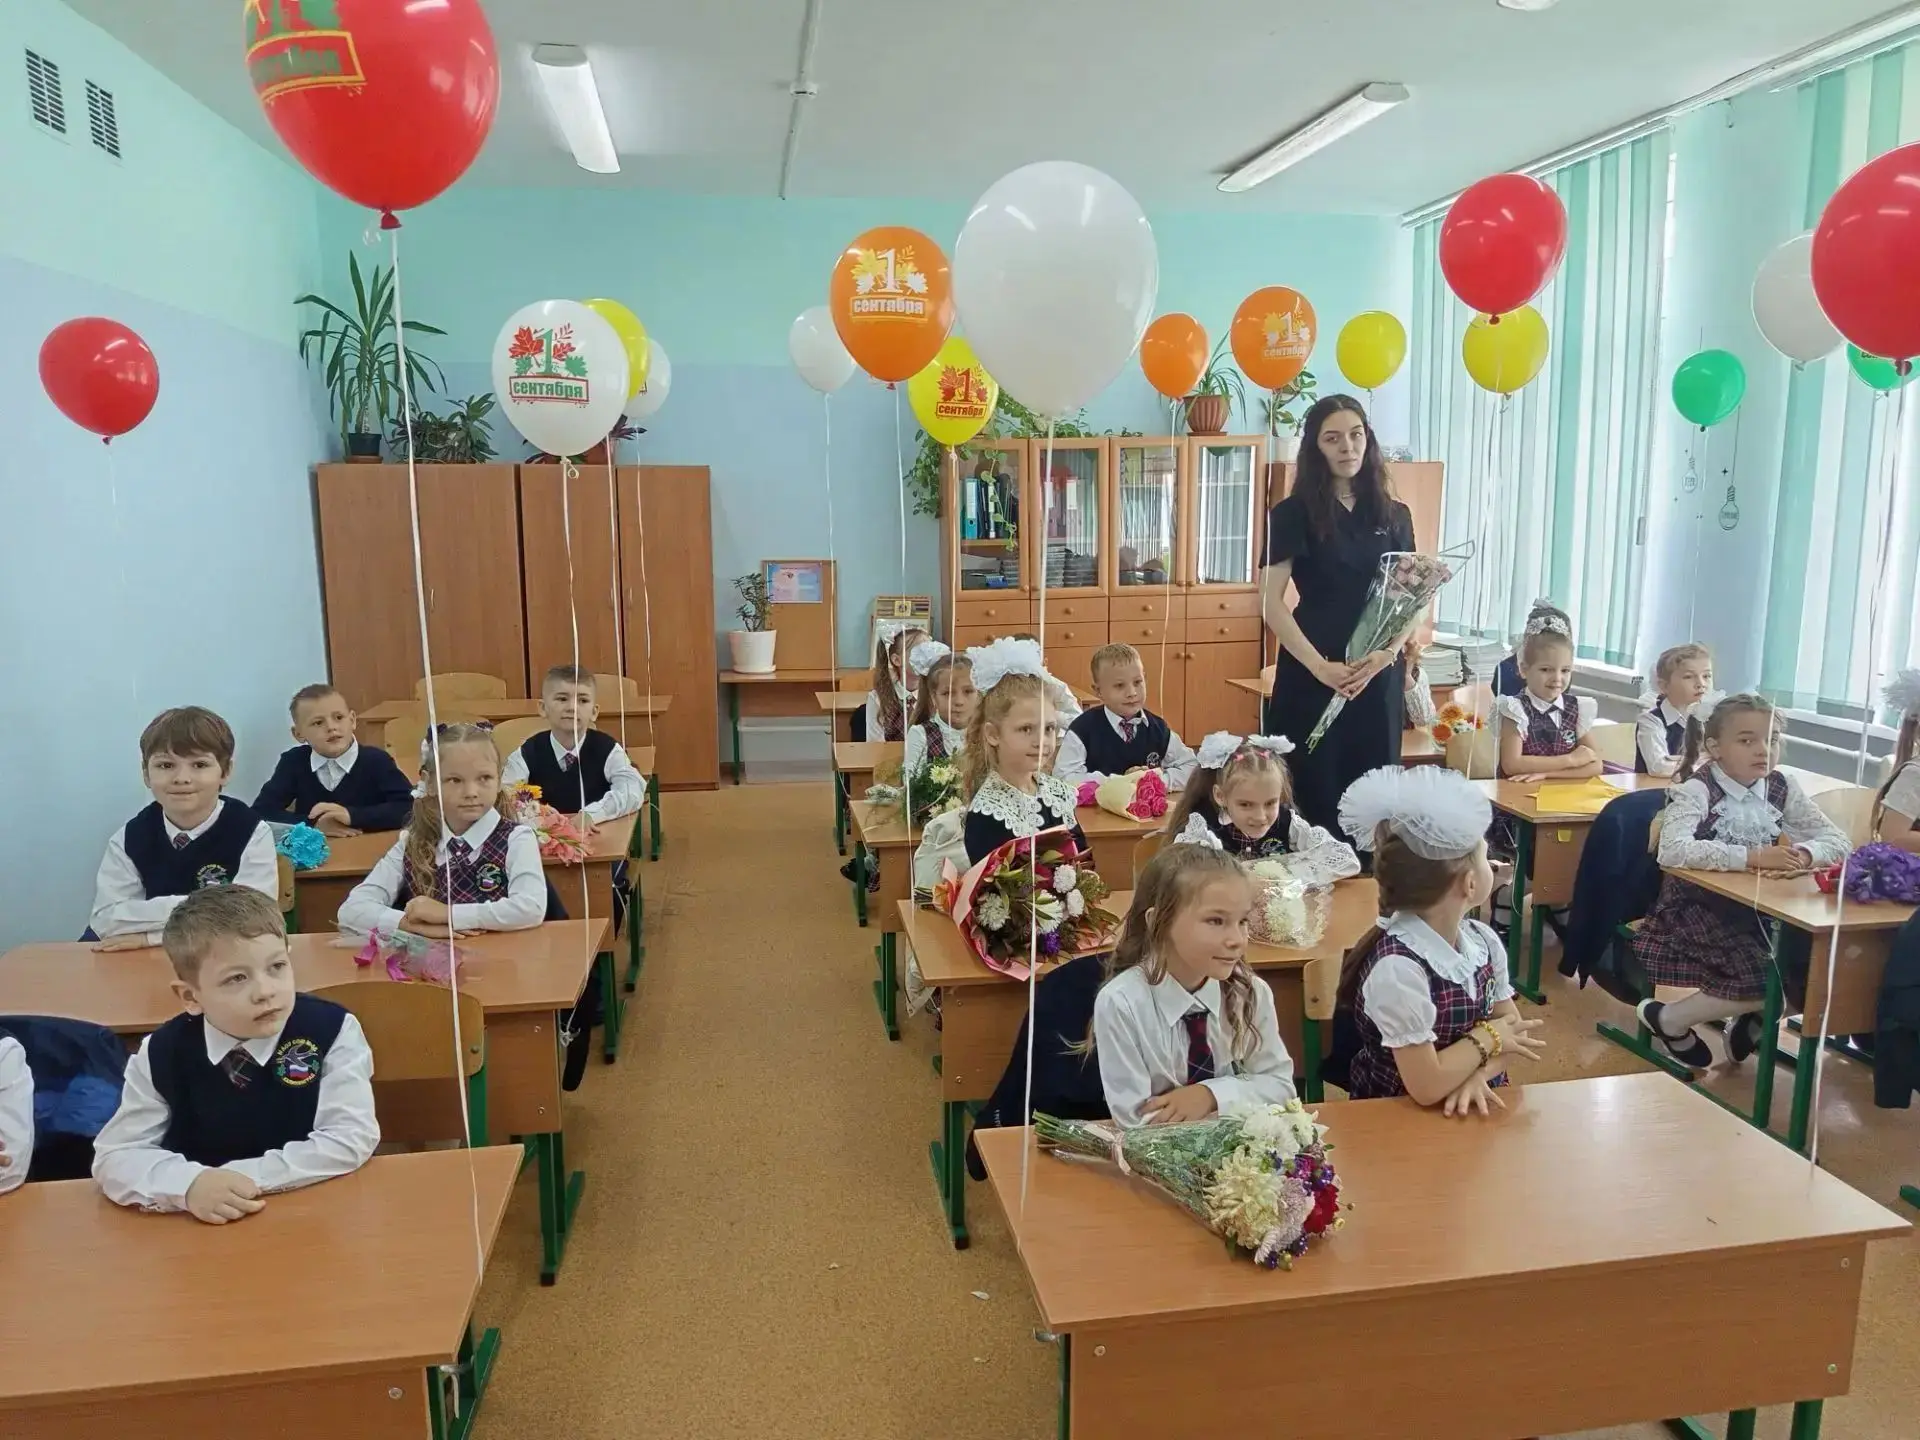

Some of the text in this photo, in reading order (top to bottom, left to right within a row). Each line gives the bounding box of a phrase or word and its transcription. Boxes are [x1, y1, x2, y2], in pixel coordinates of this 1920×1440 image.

[877, 249, 904, 293] 1
[854, 297, 925, 315] сентября
[1279, 311, 1299, 343] 1
[535, 328, 562, 376] 1
[513, 380, 584, 399] сентября
[957, 367, 974, 403] 1
[938, 404, 984, 418] сентября
